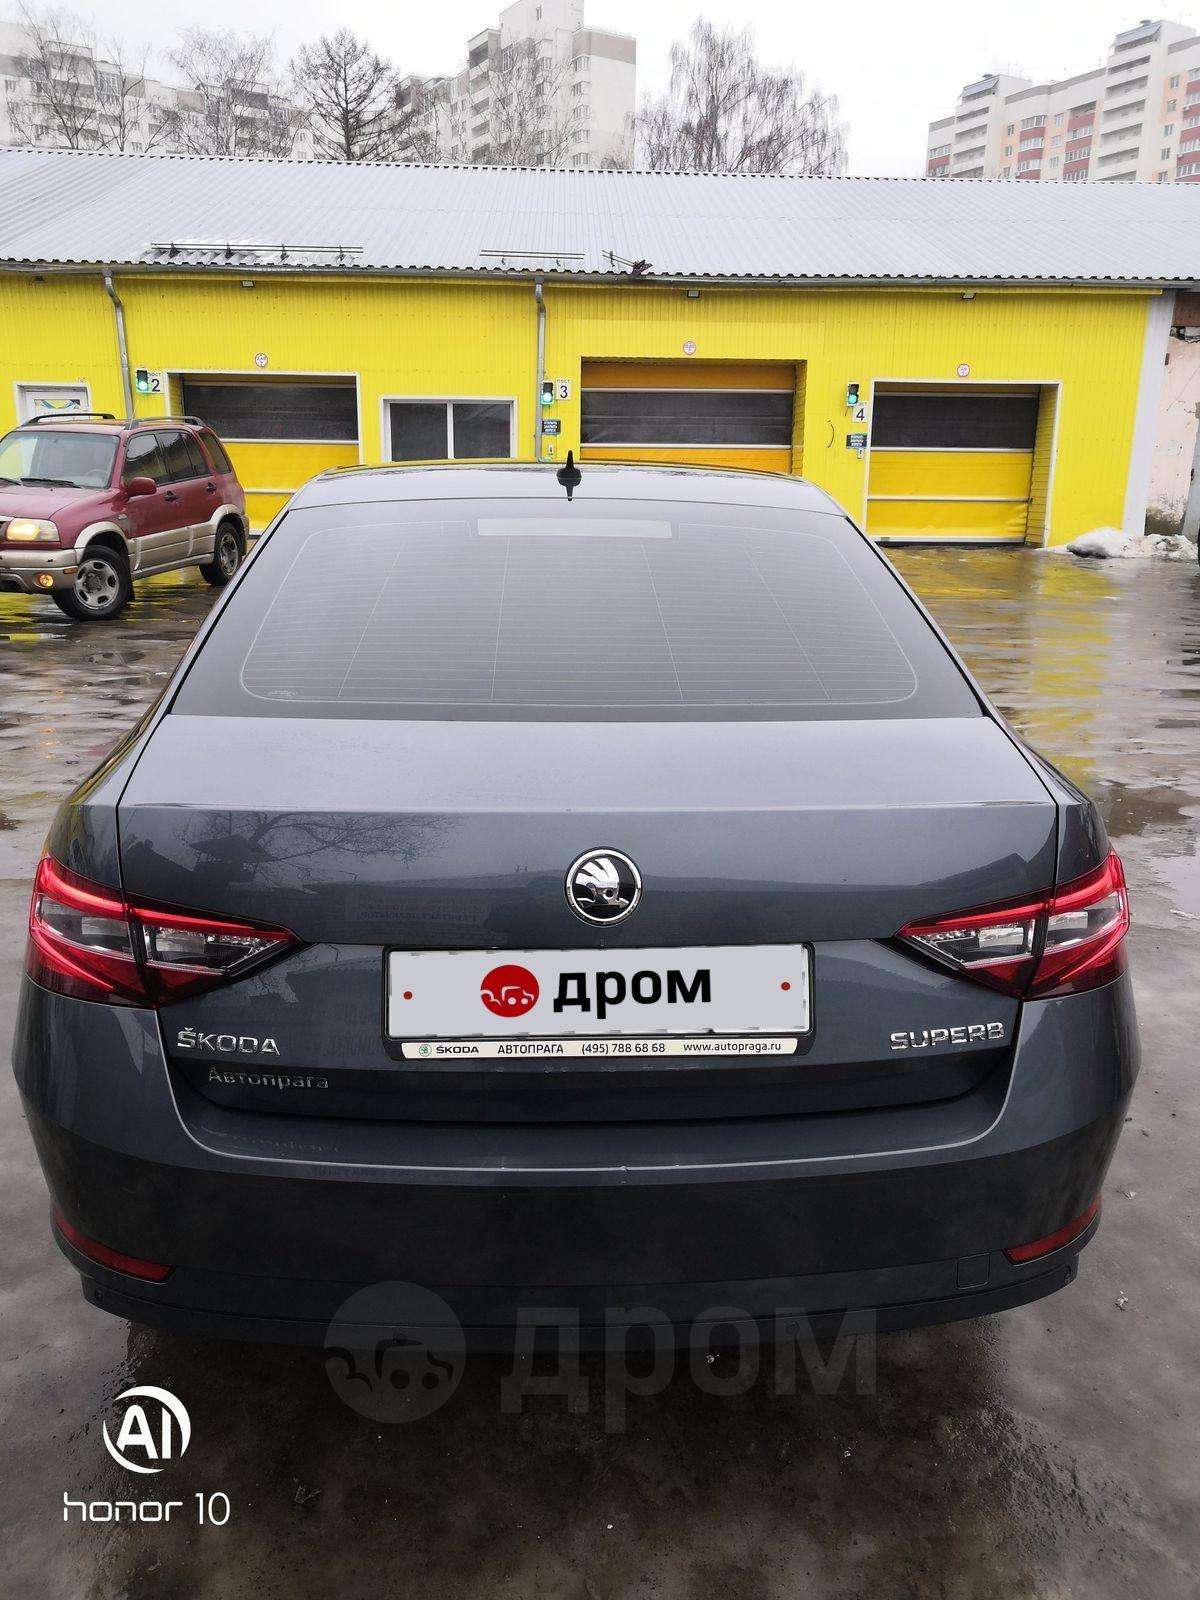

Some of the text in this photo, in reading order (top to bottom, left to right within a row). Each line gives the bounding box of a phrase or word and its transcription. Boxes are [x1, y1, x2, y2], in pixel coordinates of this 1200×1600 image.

[151, 378, 160, 391] 2
[560, 385, 568, 398] 3
[856, 407, 865, 421] 4
[177, 1027, 281, 1056] ŠKODA
[890, 1022, 1005, 1050] SUPERB
[497, 1044, 564, 1055] АВТОПРАГА
[581, 1043, 609, 1055] (495)
[611, 1043, 632, 1053] 788
[634, 1043, 649, 1053] 68
[651, 1042, 666, 1052] 68
[683, 1040, 782, 1054] www.autopraga.ru
[208, 1067, 329, 1090] Автопрага
